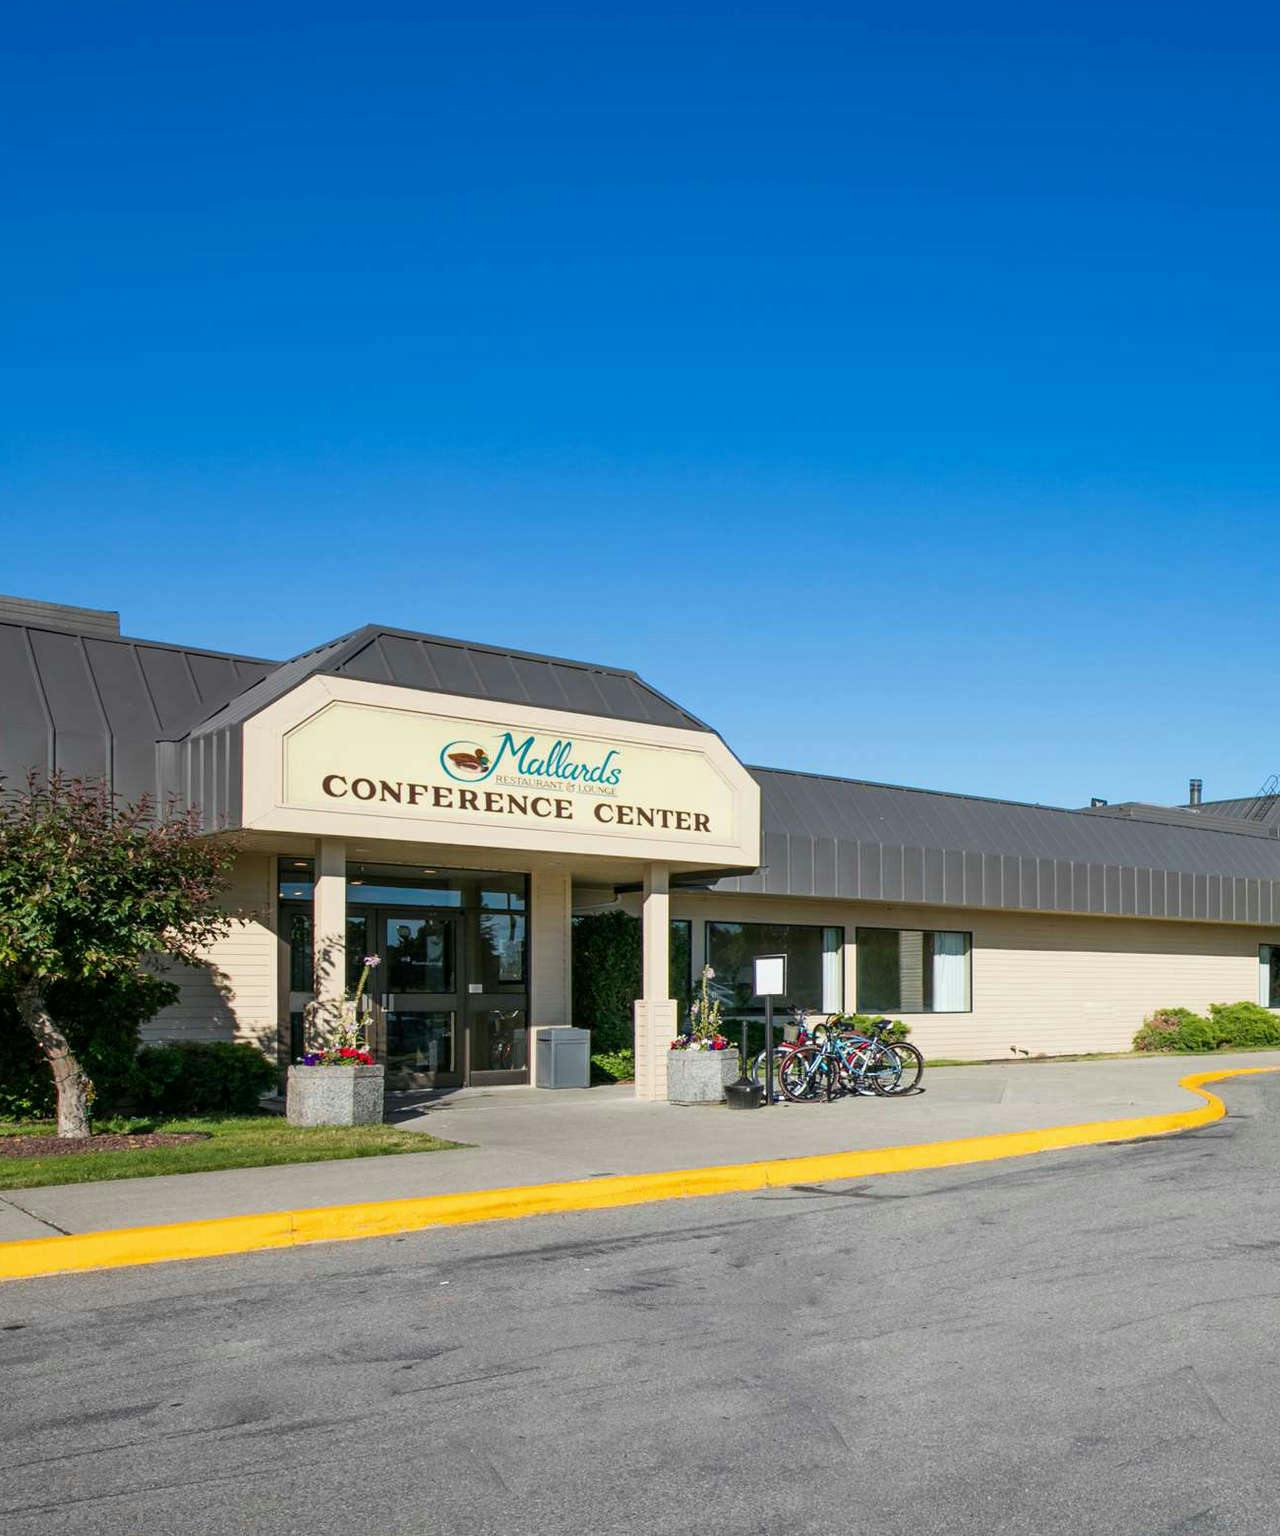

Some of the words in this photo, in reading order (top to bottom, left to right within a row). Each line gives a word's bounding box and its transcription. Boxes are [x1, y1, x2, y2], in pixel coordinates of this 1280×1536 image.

[492, 732, 622, 785] Mallards
[322, 774, 573, 819] CONFERENCE
[594, 803, 711, 832] CENTER
[495, 775, 563, 790] RESTAURANT
[566, 782, 576, 792] &
[578, 784, 617, 796] LOUNGE
